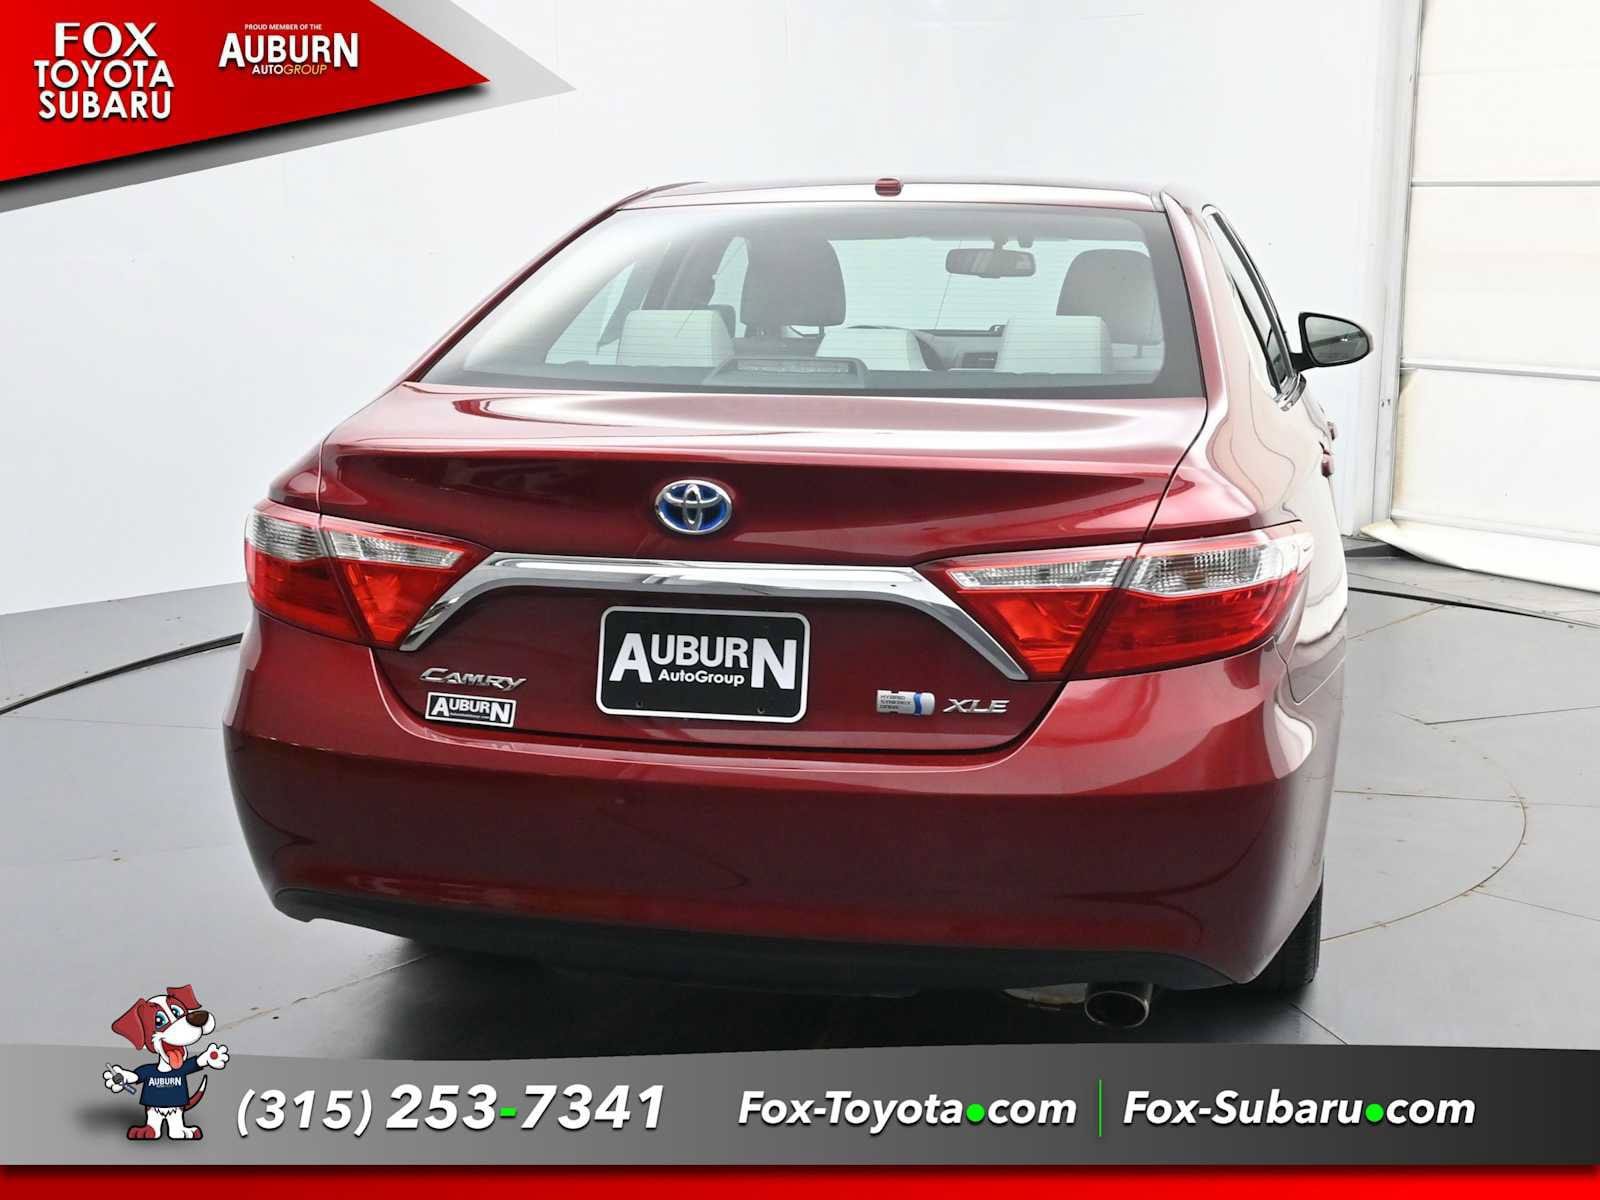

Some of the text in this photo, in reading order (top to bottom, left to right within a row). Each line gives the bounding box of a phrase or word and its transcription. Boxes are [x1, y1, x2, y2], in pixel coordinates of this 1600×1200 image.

[609, 632, 797, 690] AUBURN
[419, 667, 527, 692] CAMRY
[658, 669, 745, 688] AutoGroup
[430, 696, 511, 723] AUBURN
[942, 698, 1011, 713] XLE
